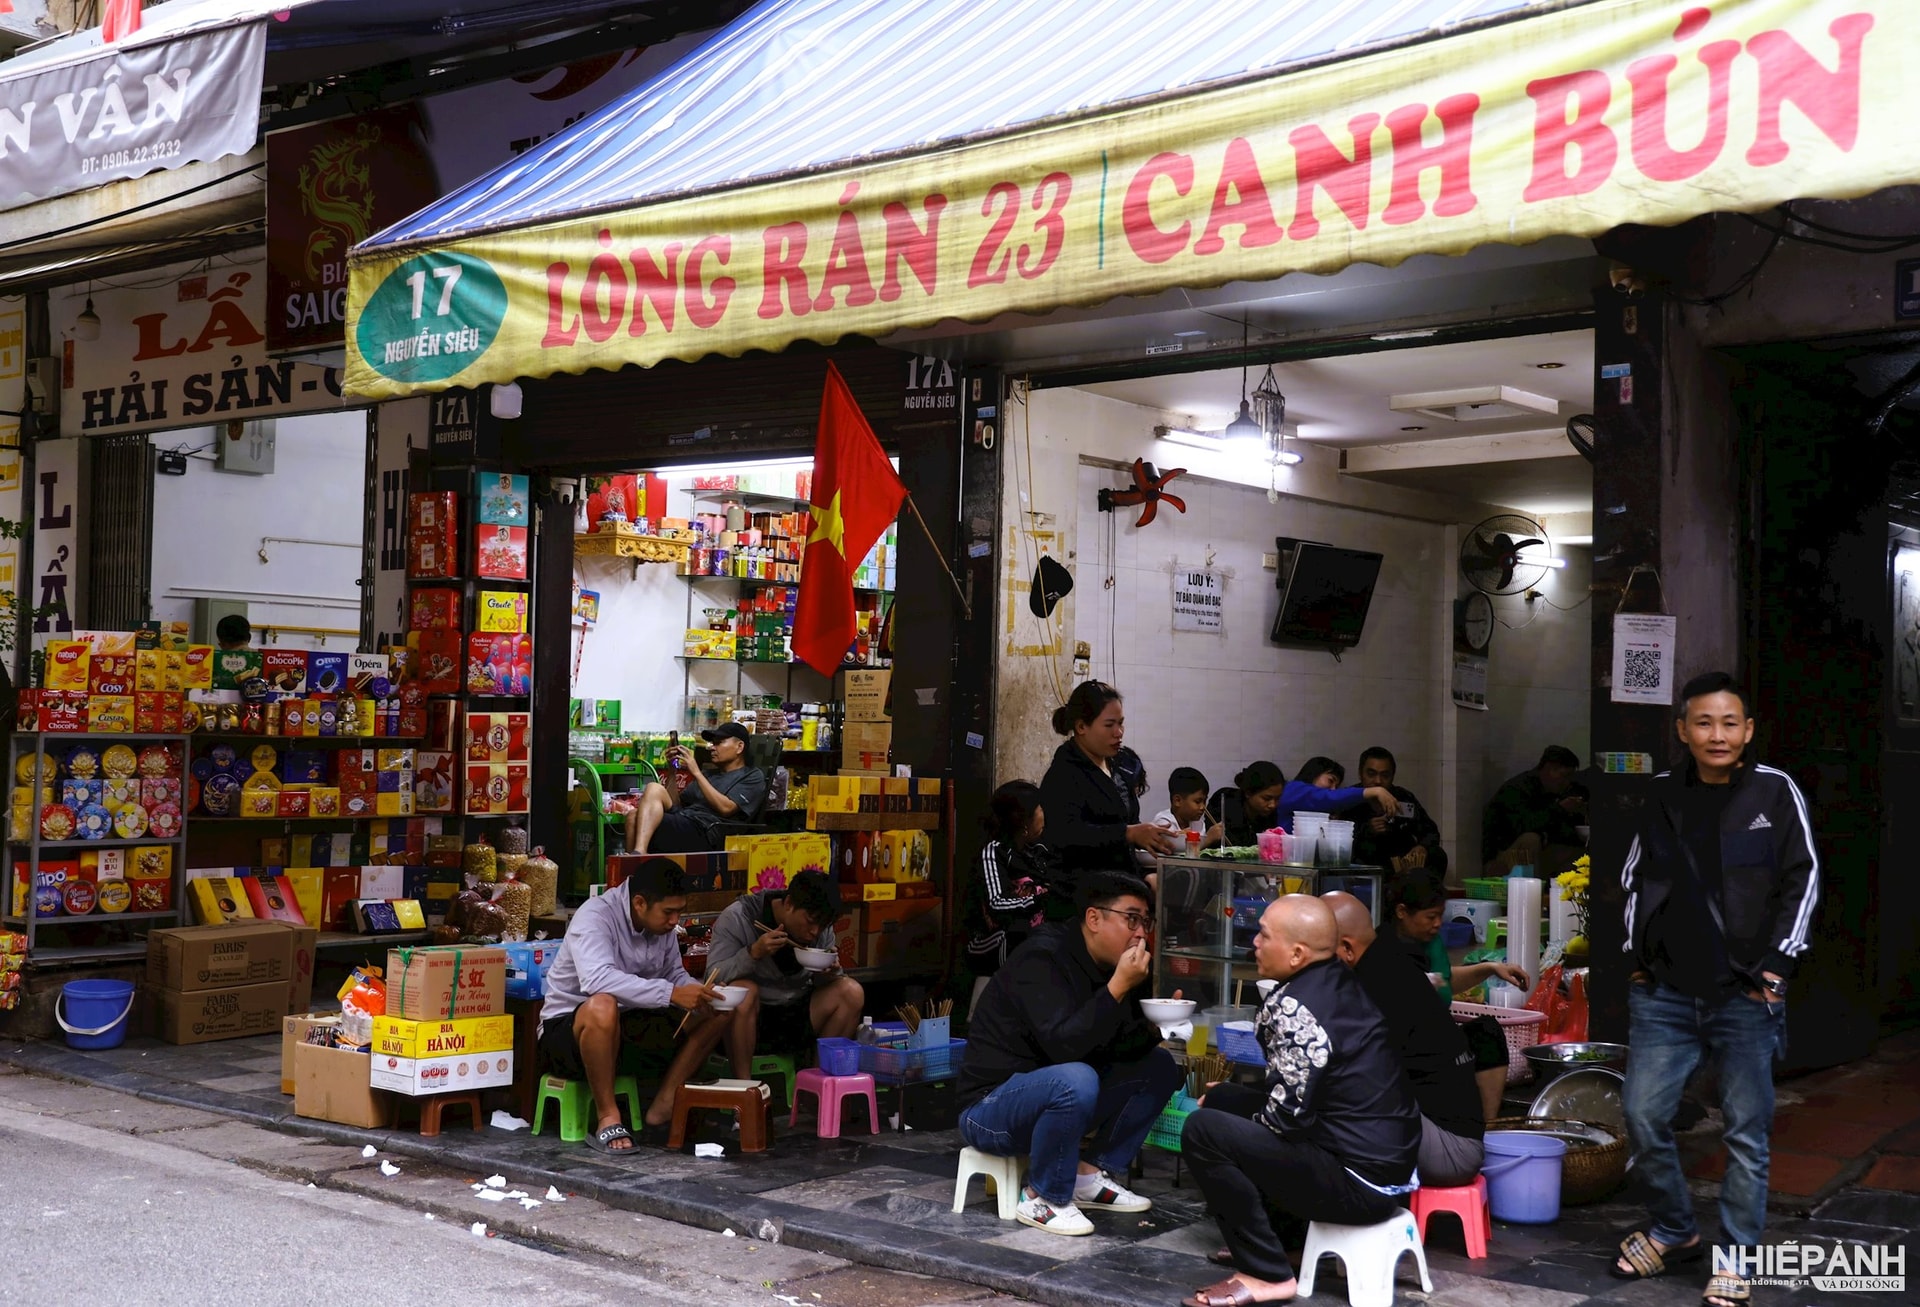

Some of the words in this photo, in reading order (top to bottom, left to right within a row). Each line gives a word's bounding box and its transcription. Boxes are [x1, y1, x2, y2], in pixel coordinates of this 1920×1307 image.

[53, 63, 192, 144] VÂN
[81, 157, 100, 175] ĐT:
[102, 139, 182, 171] 0906.22.3232
[541, 228, 736, 349] LÒNG
[756, 181, 948, 320] RÁN
[966, 171, 1073, 289] 23
[1122, 92, 1480, 264] CANH
[1522, 7, 1875, 203] BÚN
[406, 264, 462, 320] 17
[384, 326, 441, 365] NGUYỄN
[443, 325, 479, 353] SIÊU
[905, 355, 955, 390] 17A
[82, 371, 168, 430] HẢI
[904, 390, 935, 409] NGUYỄN
[937, 392, 956, 408] SIÊU
[435, 396, 470, 427] 17A
[435, 429, 459, 444] NGUYỄN
[459, 428, 473, 441] SIÊU
[266, 655, 305, 666] ChocoPie
[315, 656, 342, 667] OREO
[354, 658, 382, 670] Opéra
[99, 683, 125, 694] COSY
[47, 722, 79, 730] ChocoPie
[389, 1025, 399, 1036] BIA
[440, 1023, 454, 1034] BIA
[382, 1039, 391, 1051] HÀ
[392, 1040, 404, 1054] NỘI
[427, 1035, 445, 1052] HÀ
[445, 1034, 466, 1052] NỘI
